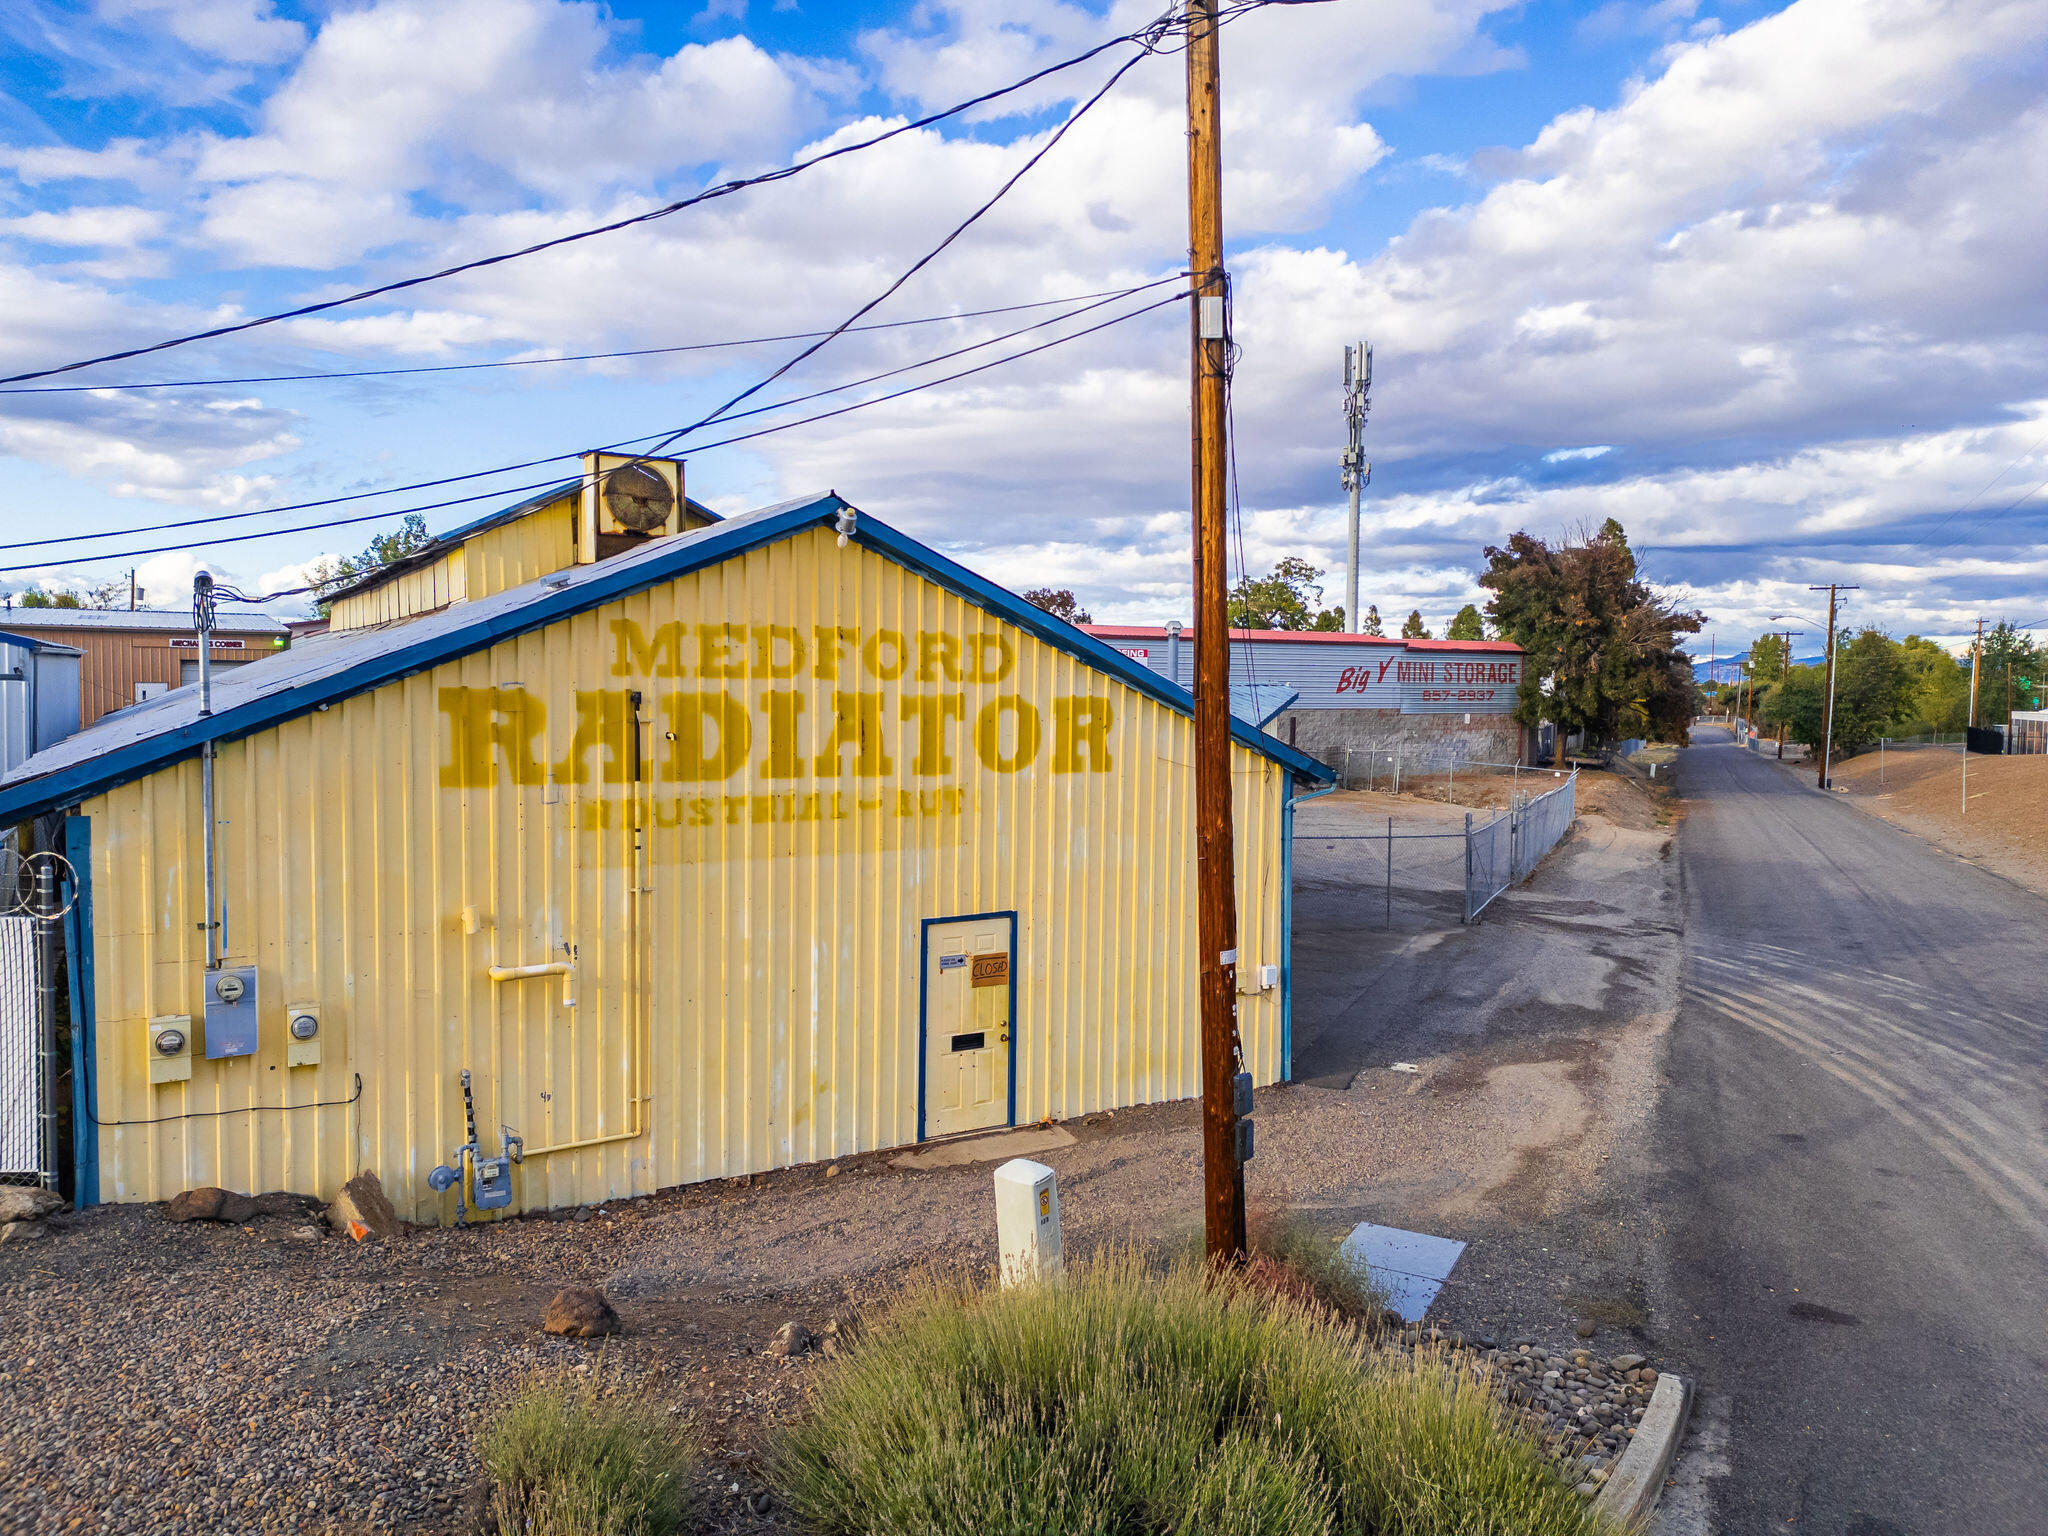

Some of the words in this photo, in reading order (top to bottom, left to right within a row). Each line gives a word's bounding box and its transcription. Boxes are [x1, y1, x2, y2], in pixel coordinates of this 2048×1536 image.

[171, 640, 214, 648] MECHAS
[610, 619, 1012, 684] MEDFORD
[1336, 666, 1371, 694] Big
[1377, 656, 1395, 684] Y
[1397, 661, 1435, 684] MINI
[1443, 662, 1517, 684] STORAGE
[438, 687, 1112, 788] RADIATOR
